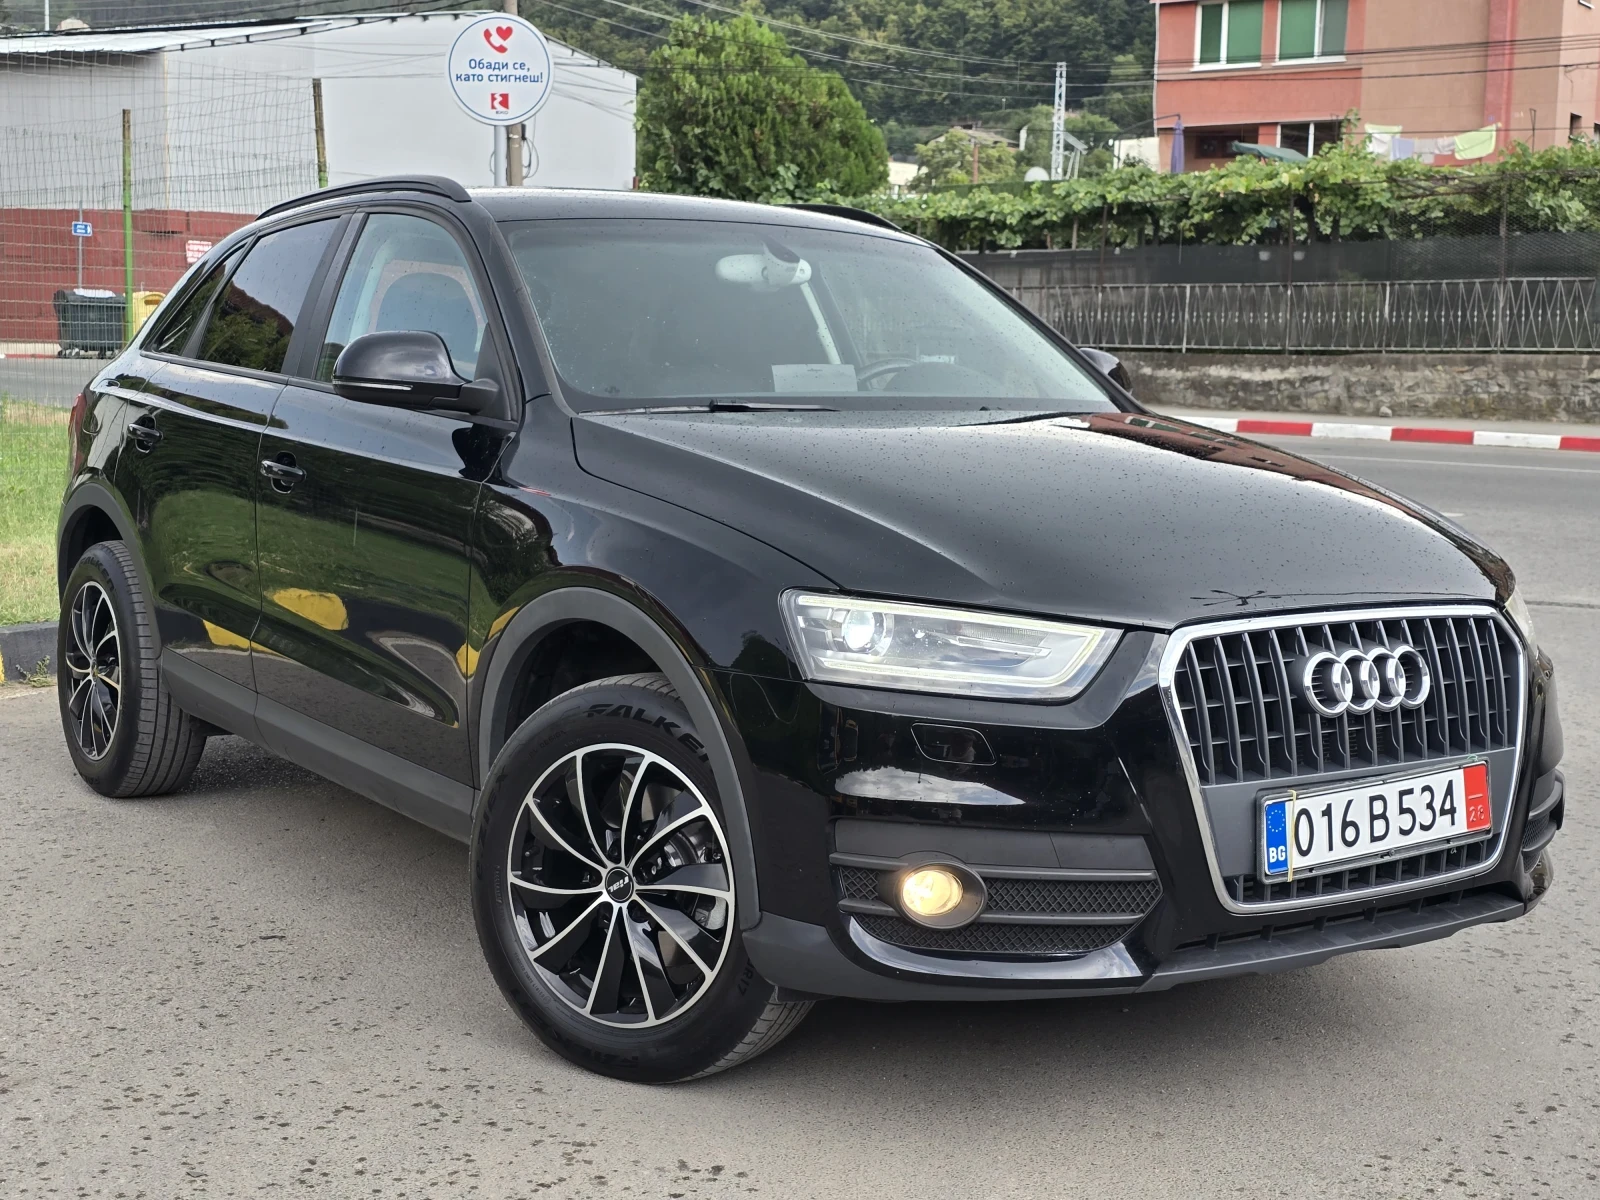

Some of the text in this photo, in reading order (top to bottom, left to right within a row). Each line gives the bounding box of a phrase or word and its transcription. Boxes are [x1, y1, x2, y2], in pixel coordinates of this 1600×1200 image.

[468, 58, 530, 72] Обади се,
[455, 72, 543, 83] като стигнеш!
[1294, 779, 1457, 857] 016B534
[1469, 804, 1485, 822] 28
[1269, 845, 1287, 863] BG
